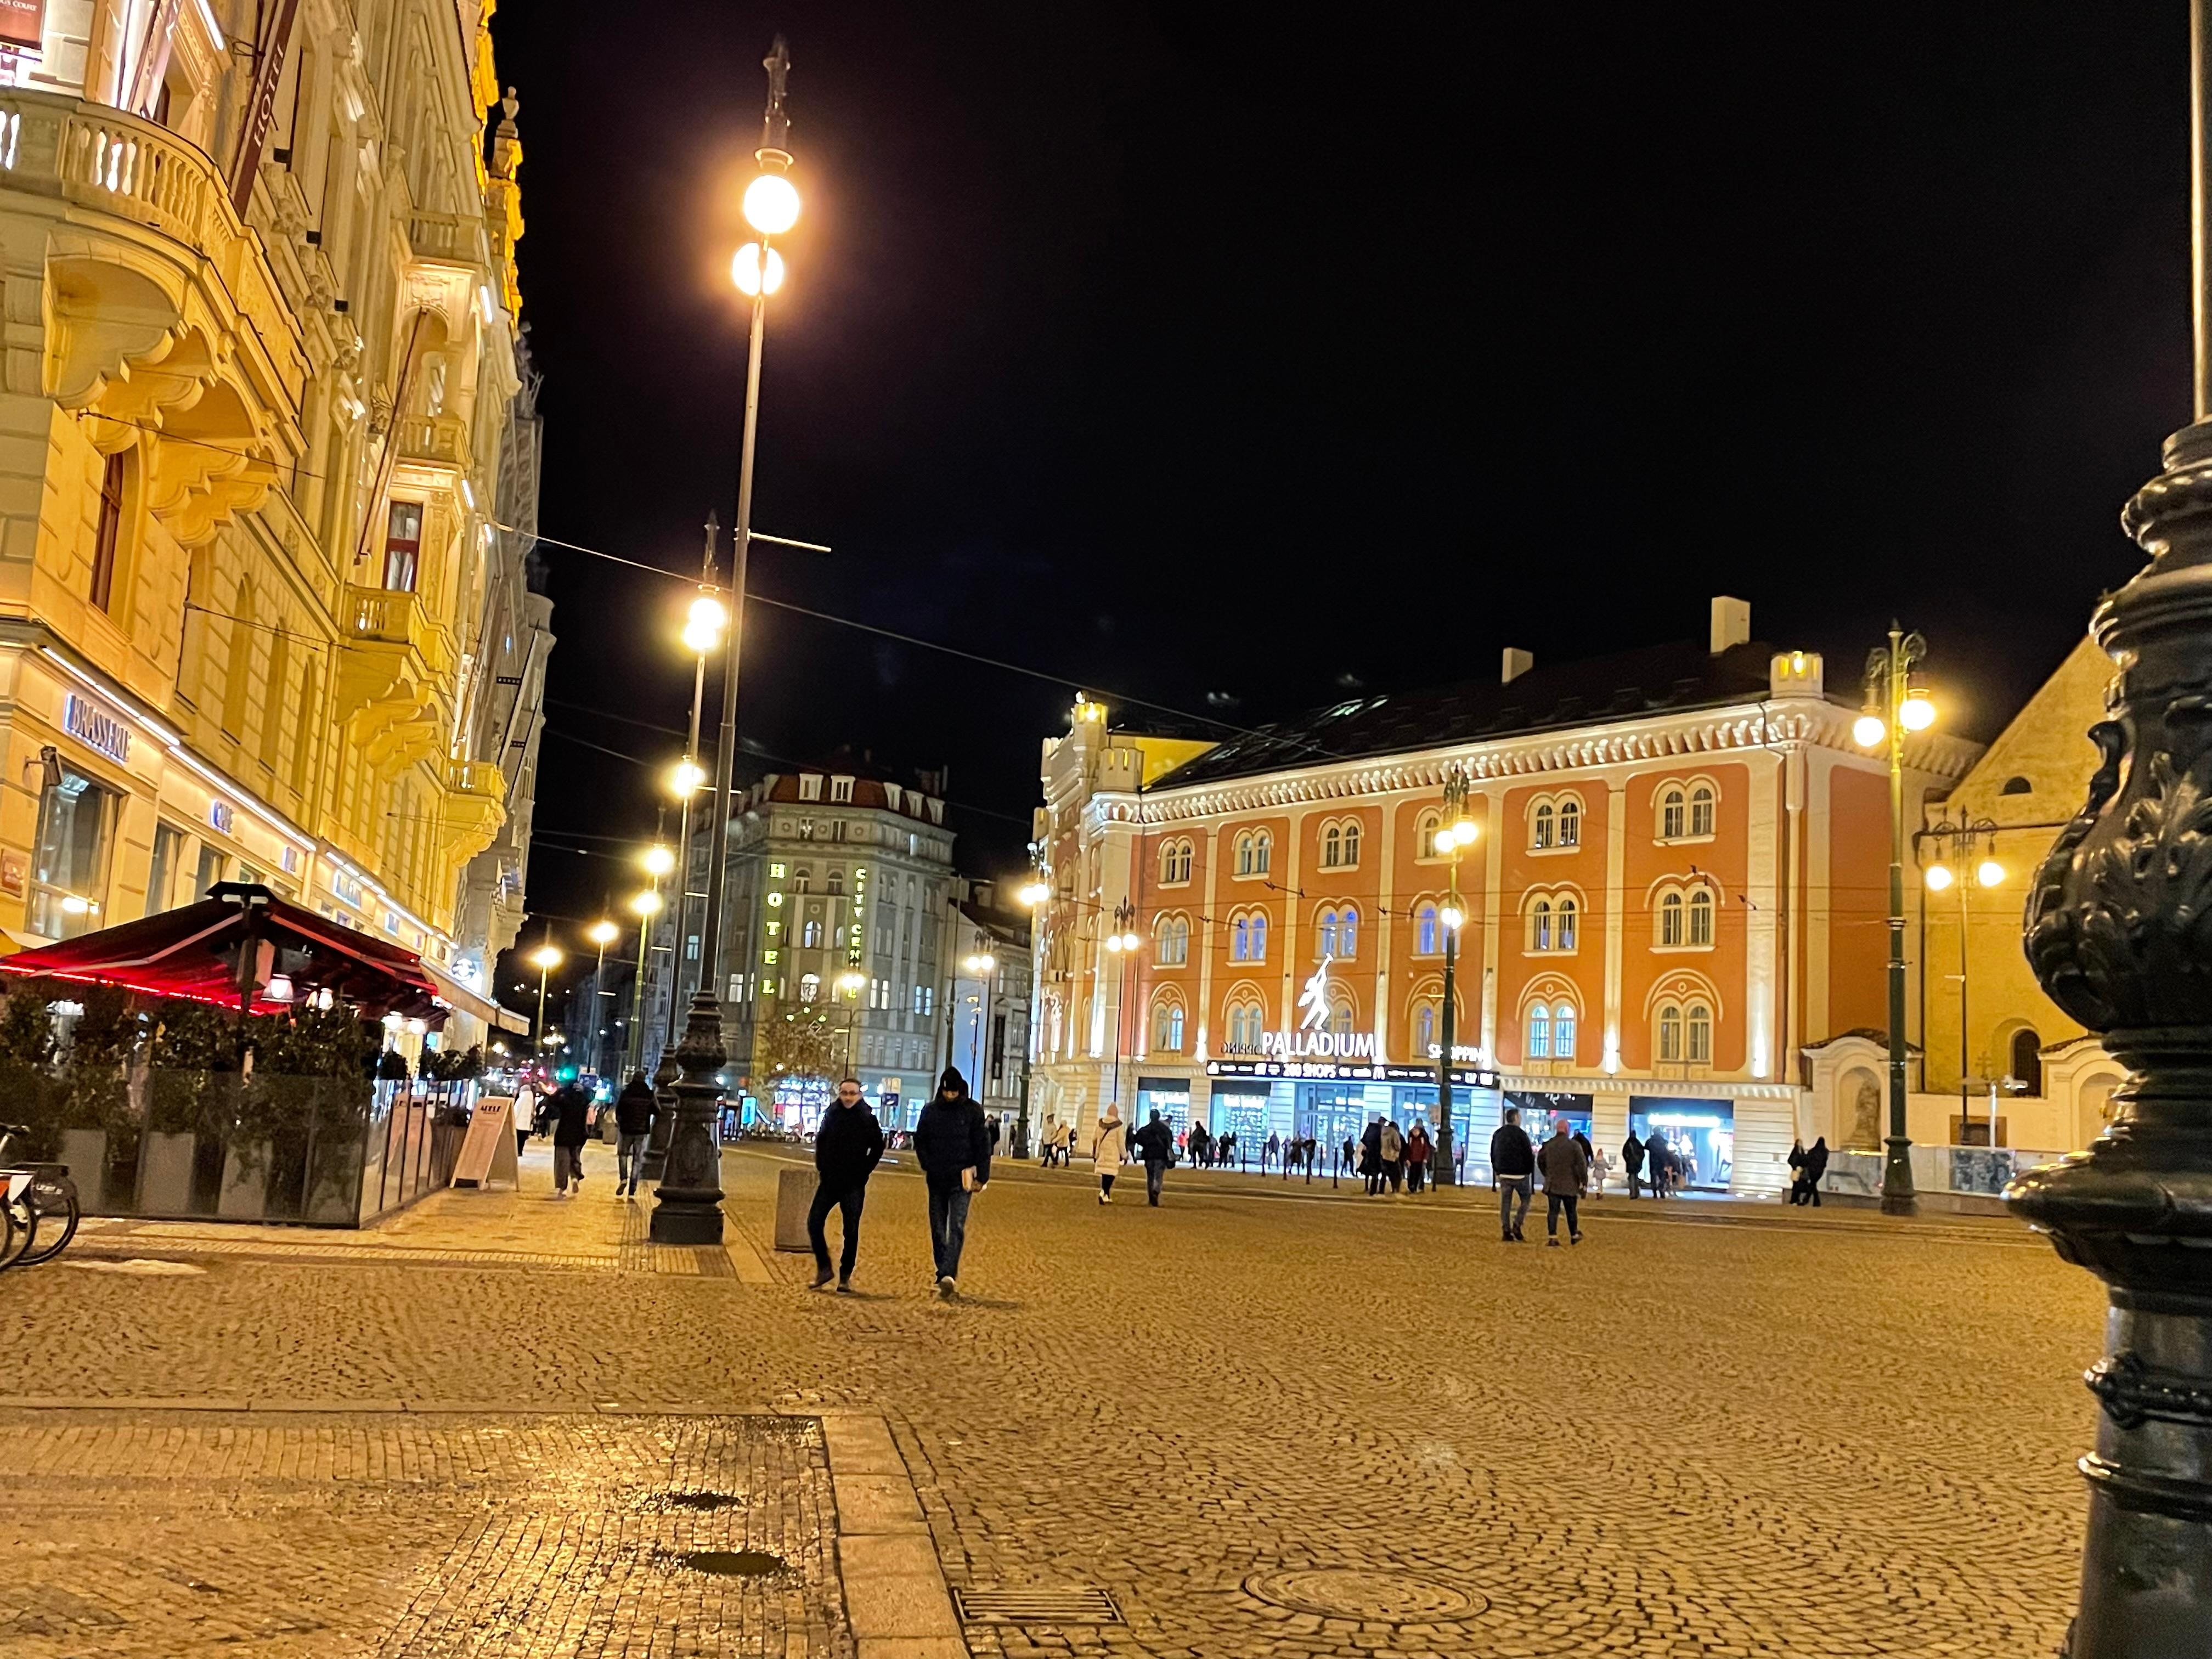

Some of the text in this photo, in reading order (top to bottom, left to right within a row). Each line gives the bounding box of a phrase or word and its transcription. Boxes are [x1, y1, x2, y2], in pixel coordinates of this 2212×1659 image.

[762, 863, 785, 995] HOTEL
[1262, 1031, 1374, 1058] PALLADIUM
[1302, 1063, 1336, 1079] SHOPS
